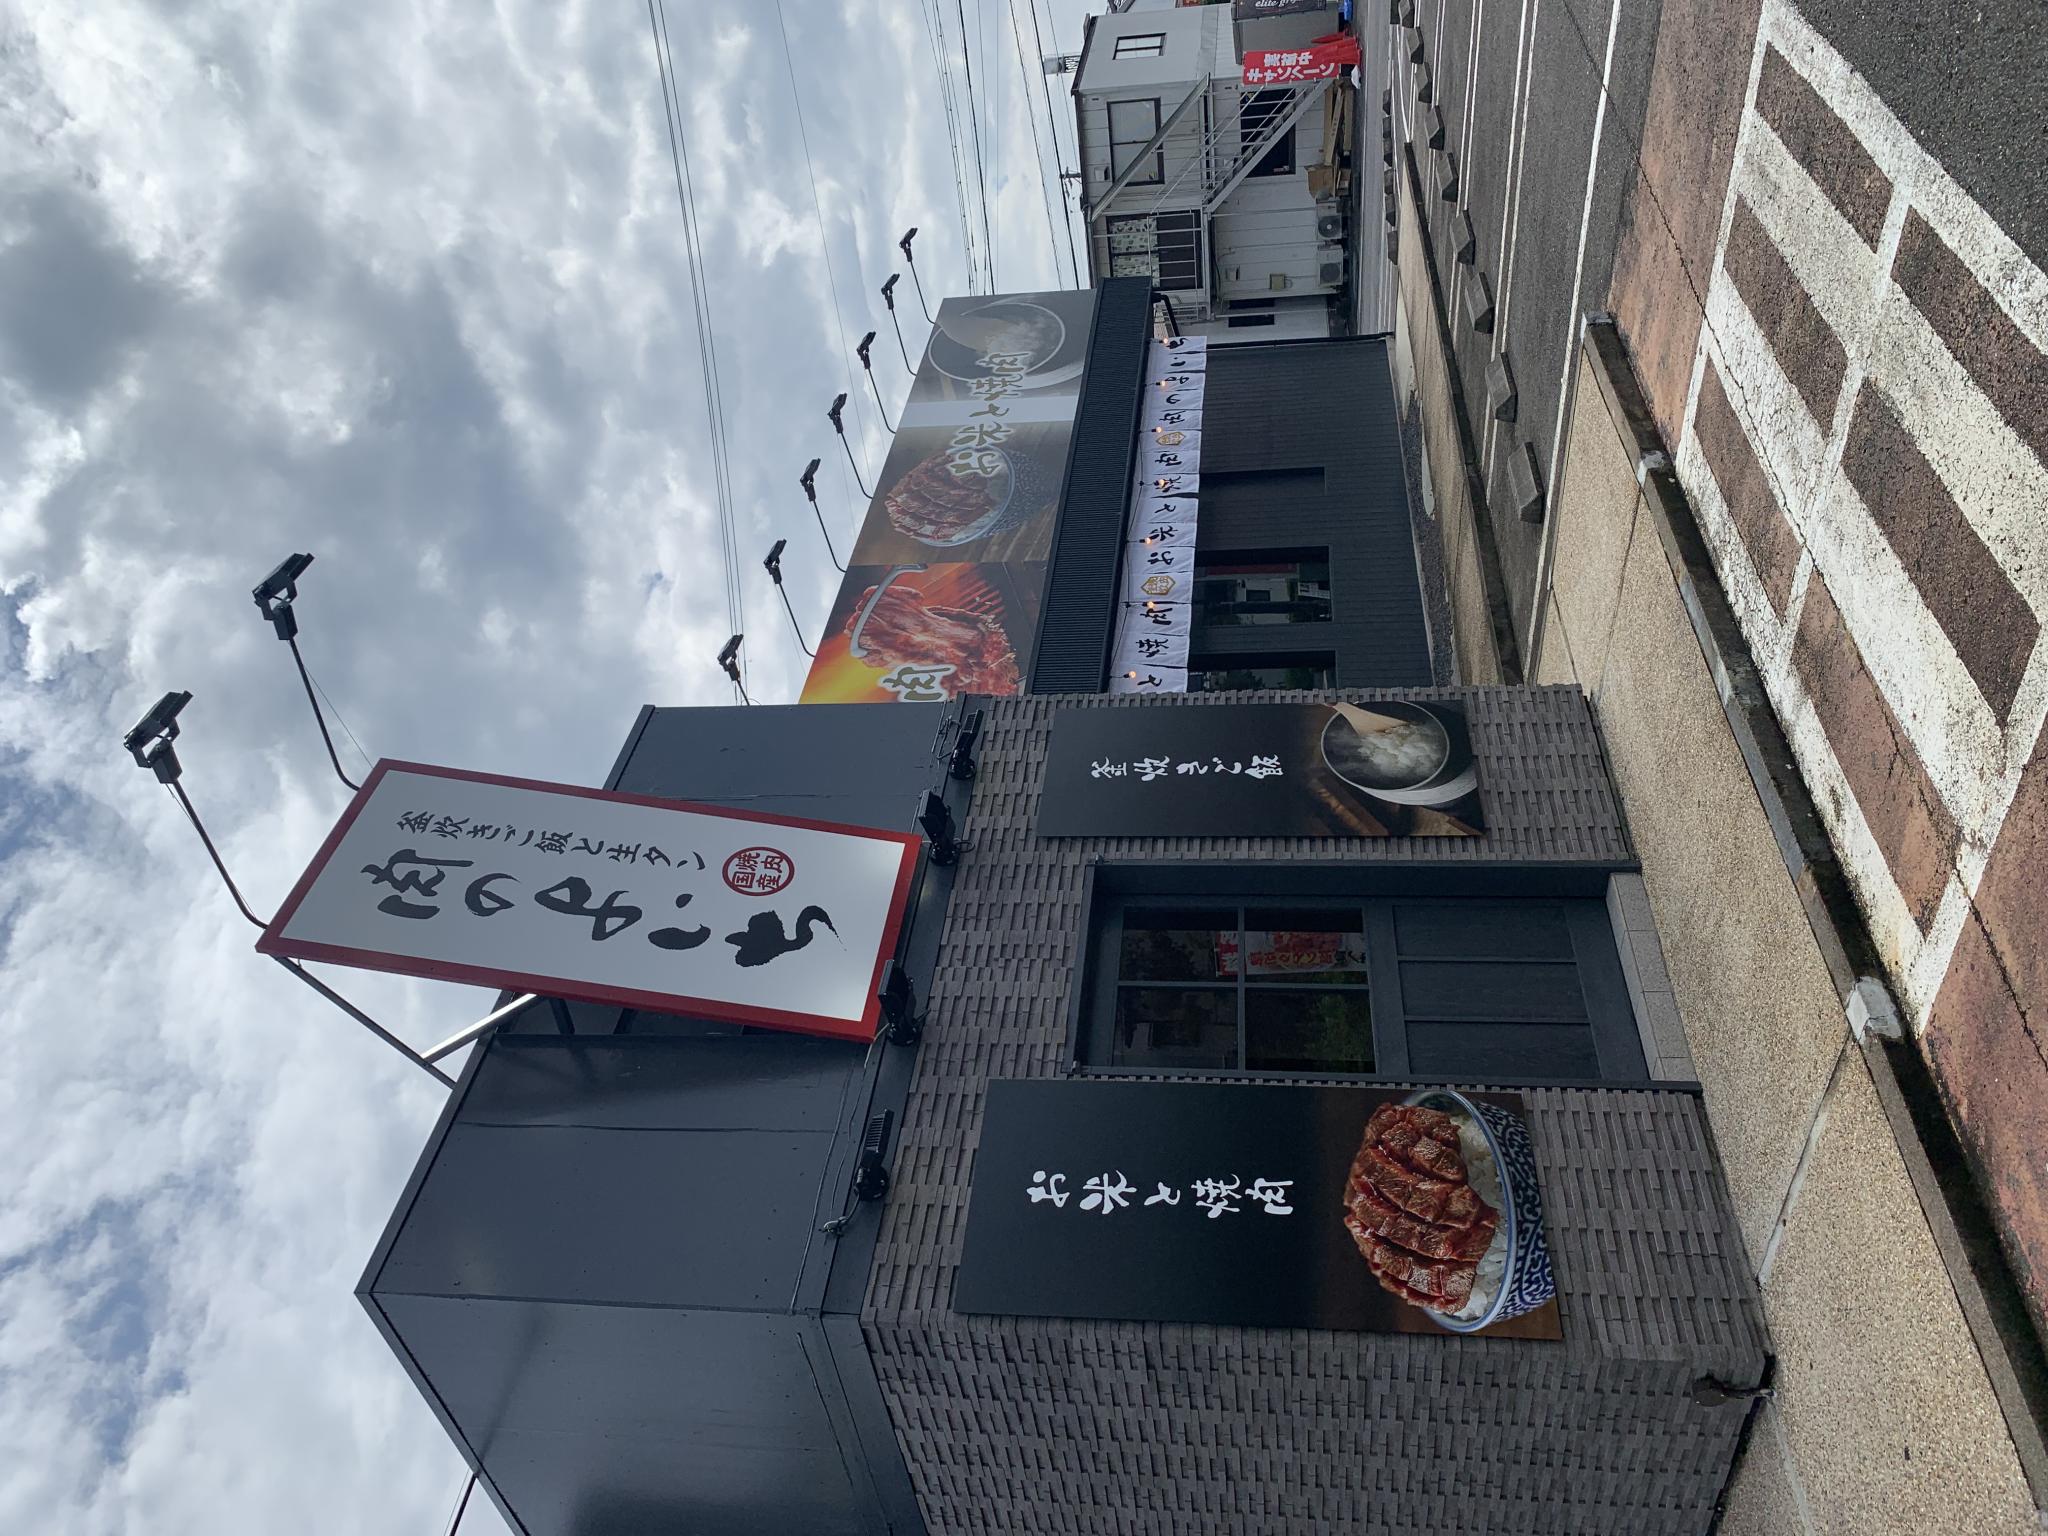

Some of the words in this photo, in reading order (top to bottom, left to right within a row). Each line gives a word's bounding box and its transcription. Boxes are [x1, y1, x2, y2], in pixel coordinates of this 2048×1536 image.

[948, 352, 1030, 476] お米と焼肉
[1090, 753, 1284, 782] 釜炊きご飯
[396, 810, 707, 871] 釜炊きご飯と生タン
[360, 848, 848, 968] 肉のよいち
[1026, 1170, 1293, 1218] お米と焼肉
